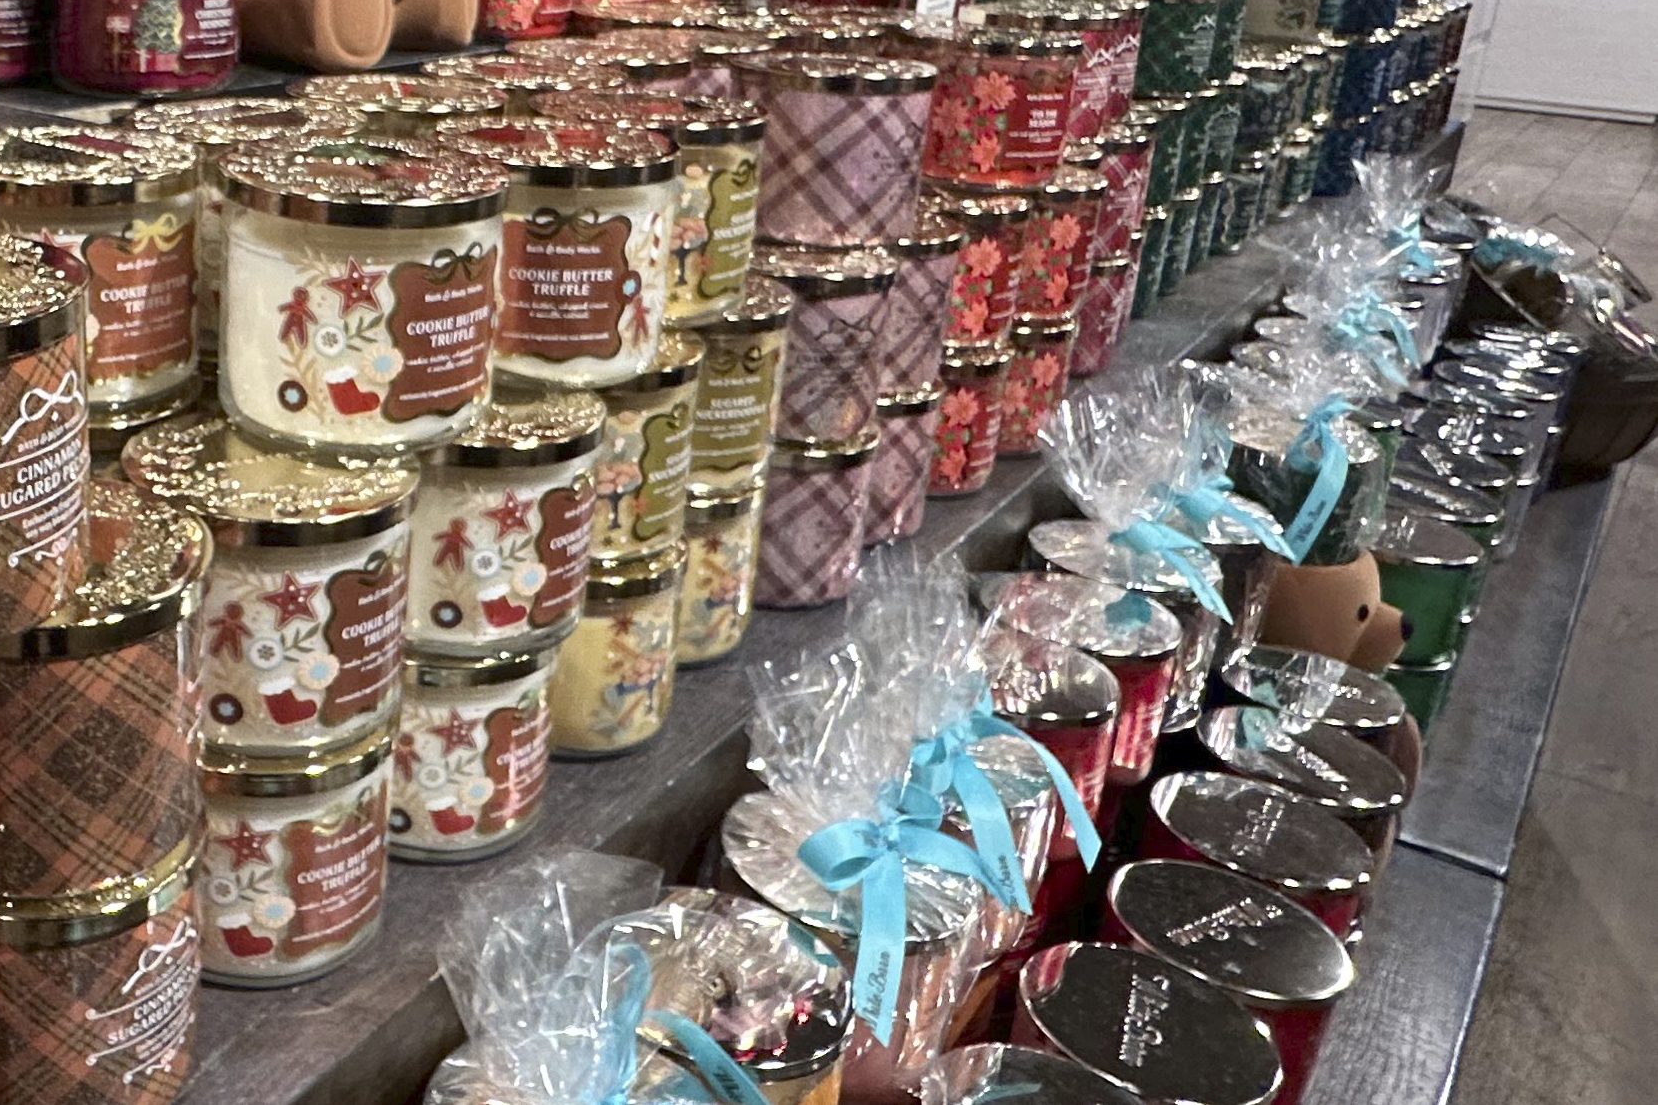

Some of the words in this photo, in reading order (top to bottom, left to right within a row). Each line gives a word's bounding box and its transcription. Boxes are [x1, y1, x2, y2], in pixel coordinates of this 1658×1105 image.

[508, 267, 559, 282] COOKIE
[563, 269, 613, 282] BUTTER
[533, 283, 590, 296] TRUFFLE
[407, 316, 454, 335] COOKIE
[430, 326, 476, 348] TRUFFLE
